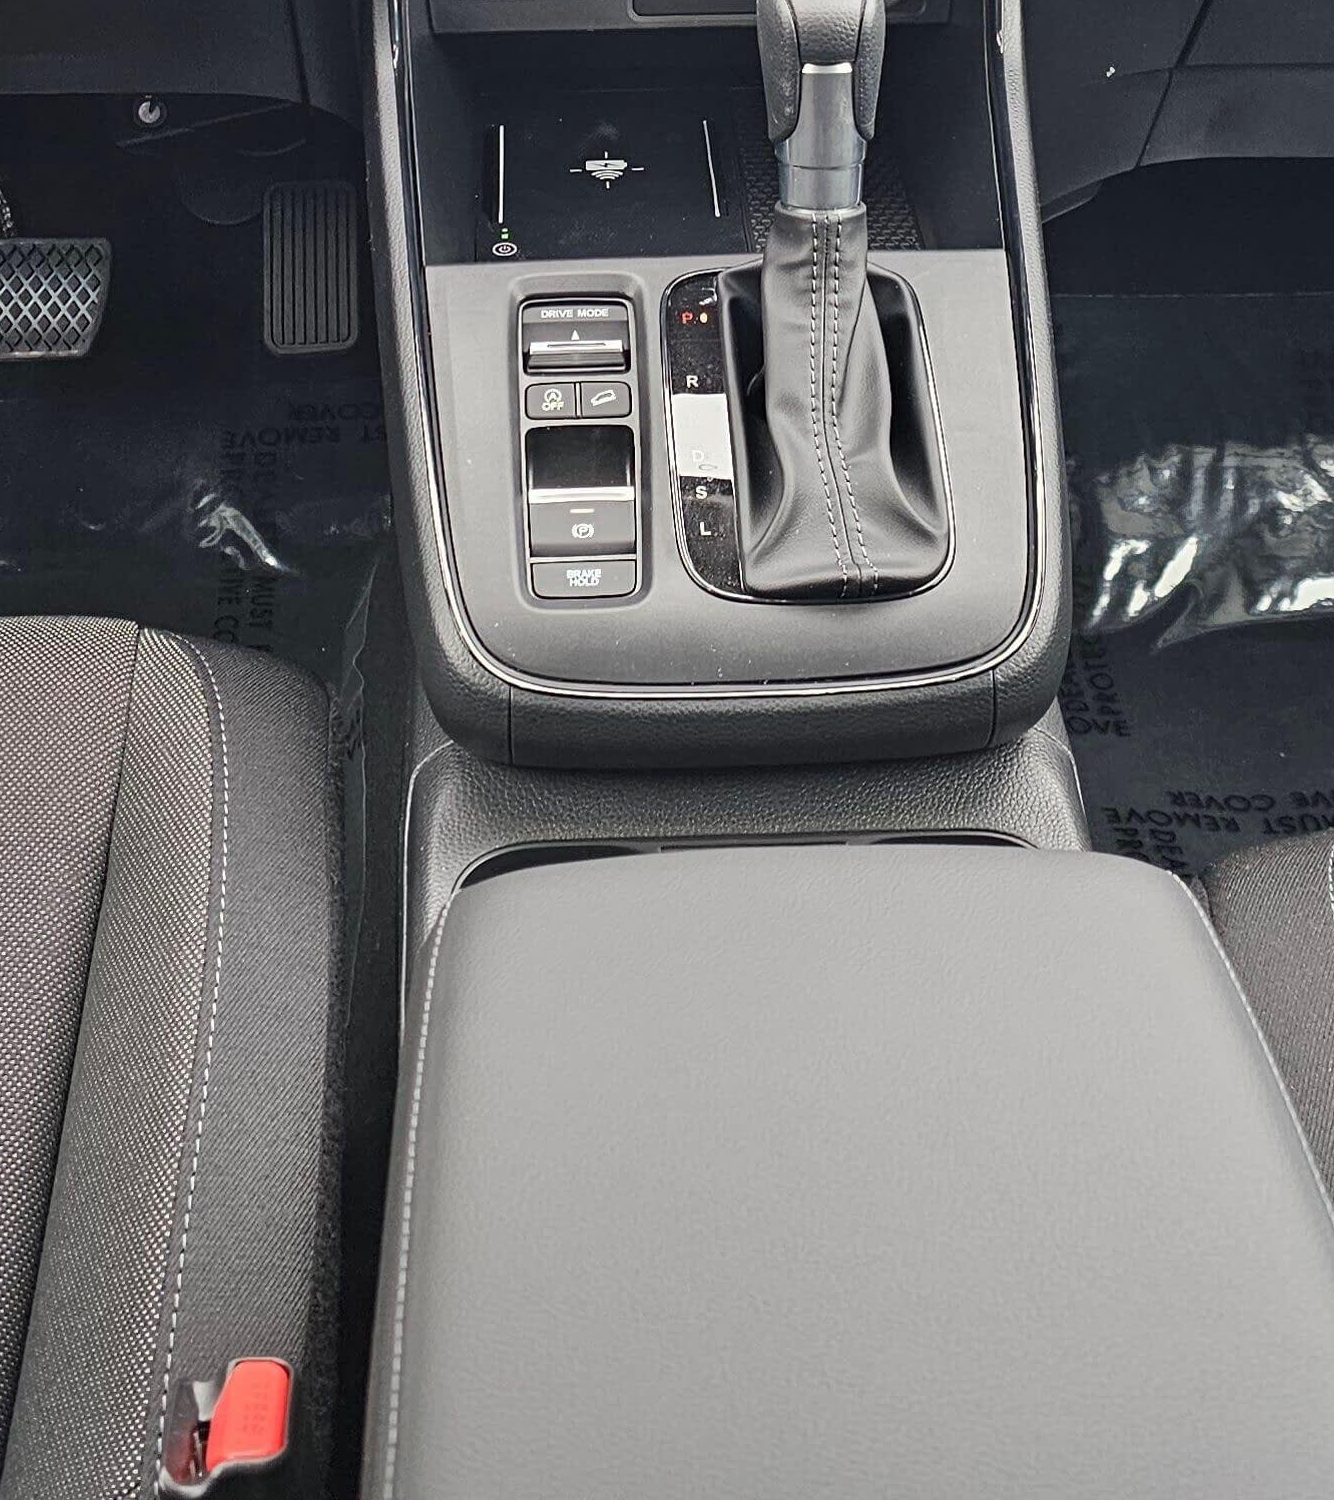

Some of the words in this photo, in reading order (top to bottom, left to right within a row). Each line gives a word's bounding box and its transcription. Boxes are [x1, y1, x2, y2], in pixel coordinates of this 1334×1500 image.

[541, 309, 573, 319] DRIVE
[577, 308, 609, 318] MODE
[682, 311, 693, 323] P
[686, 375, 699, 388] R
[542, 401, 564, 411] OFF
[692, 450, 705, 463] D
[695, 486, 708, 499] S
[699, 521, 712, 536] L
[566, 569, 602, 579] BRAKE
[569, 578, 600, 587] HOLD
[1166, 789, 1275, 813] COVER
[1100, 806, 1241, 833] REMOVE
